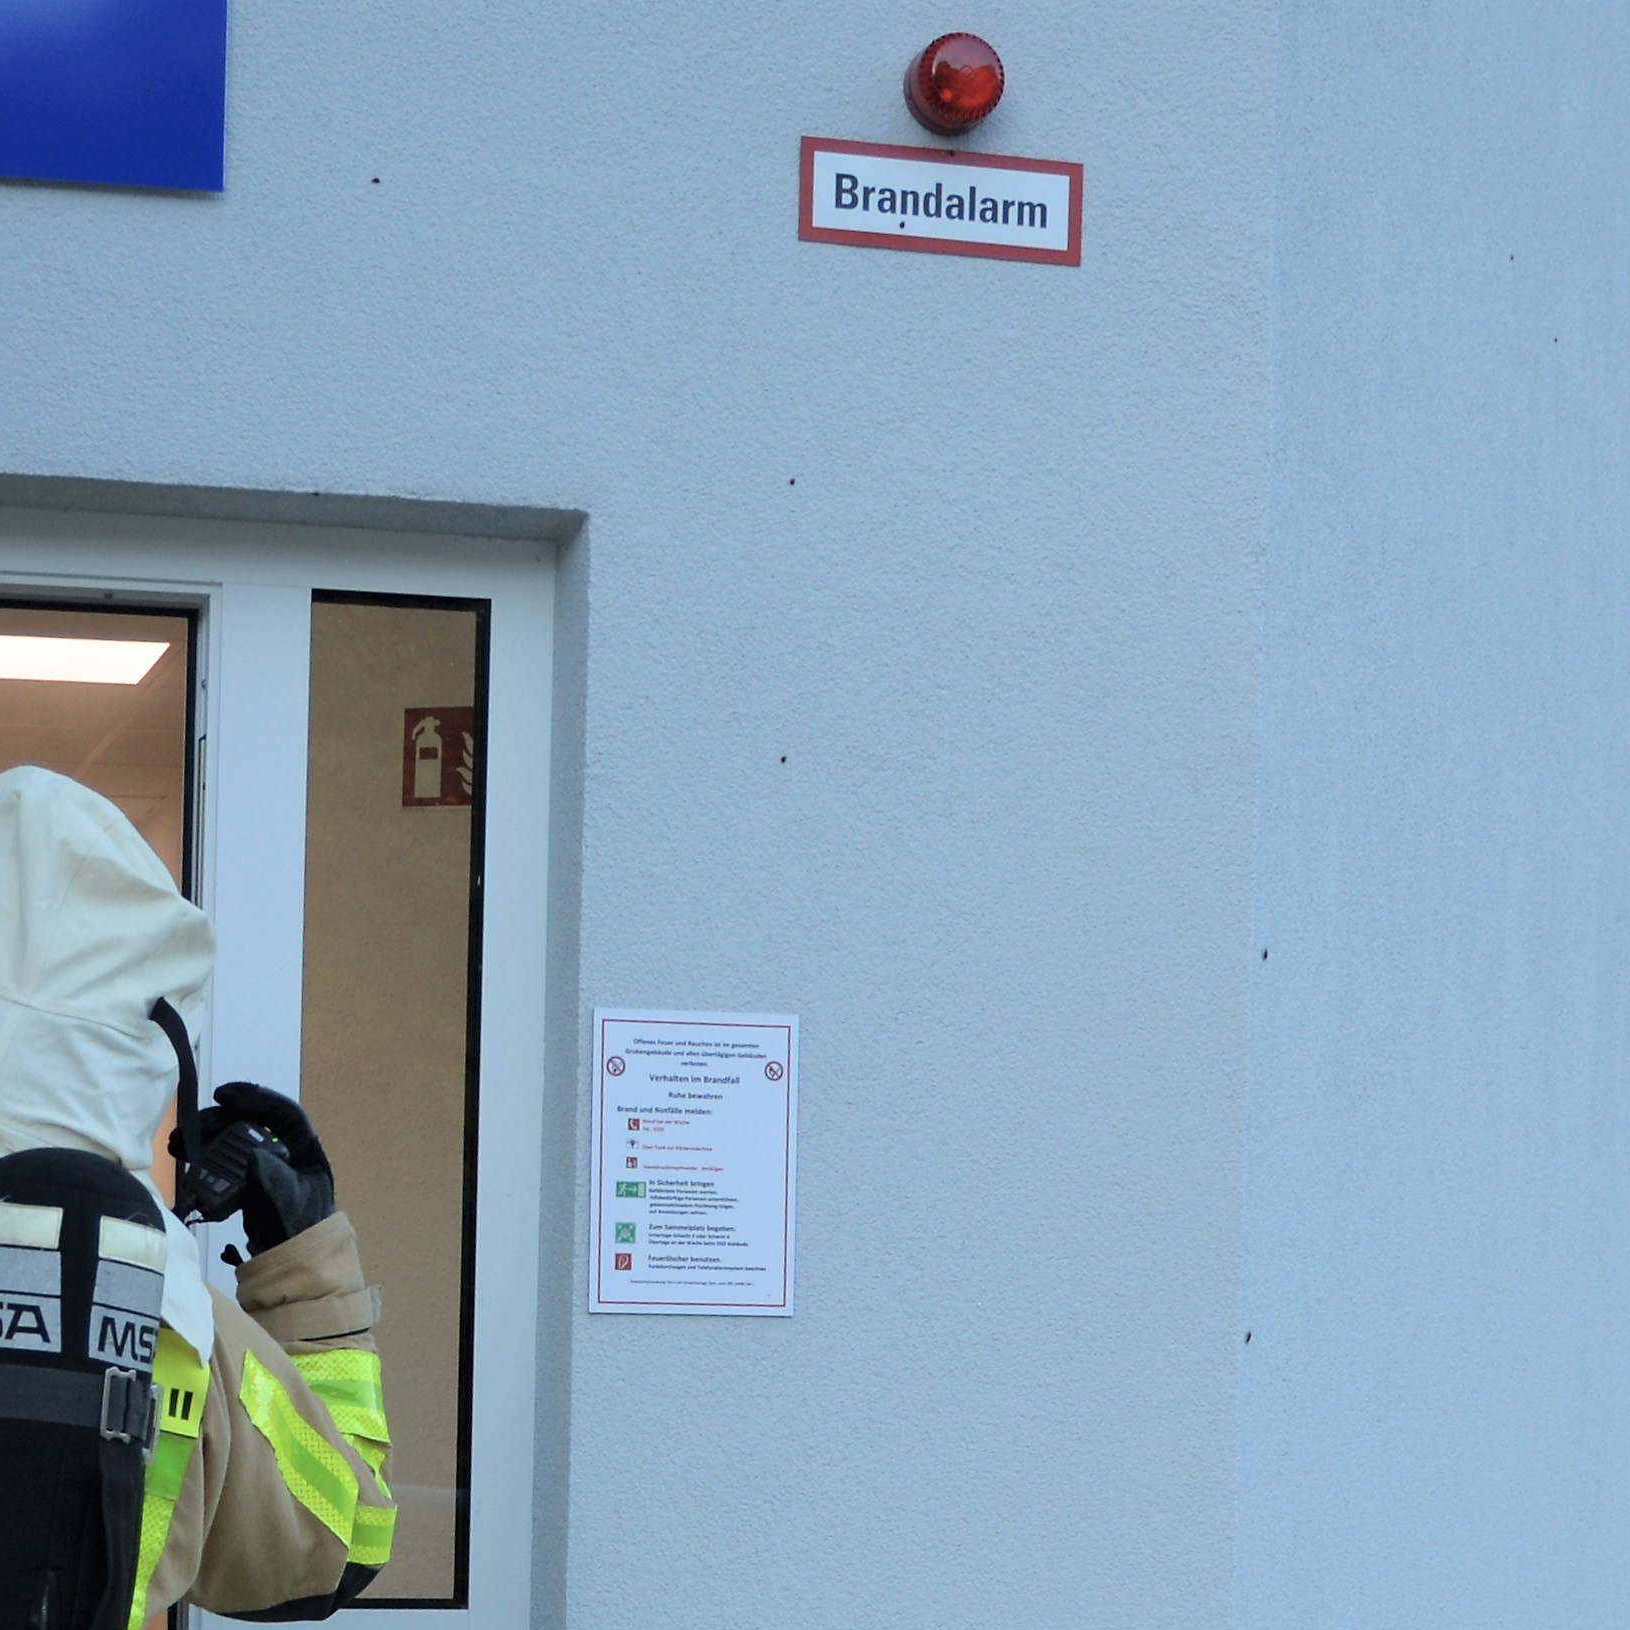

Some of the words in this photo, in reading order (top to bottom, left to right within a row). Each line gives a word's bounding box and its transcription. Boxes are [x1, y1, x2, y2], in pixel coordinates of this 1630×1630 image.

[835, 173, 1047, 229] Brandalarm
[649, 1074, 689, 1084] Verhalten
[691, 1076, 701, 1084] im
[703, 1076, 740, 1085] Brandfall
[668, 1091, 686, 1099] Ruhe
[688, 1092, 723, 1100] bewahren
[639, 1106, 653, 1114] und
[655, 1106, 682, 1115] Notfälle
[684, 1108, 713, 1116] melden:
[657, 1179, 689, 1187] Sicherheit
[690, 1180, 715, 1188] bringen
[665, 1224, 705, 1233] Sammelplatz
[648, 1255, 689, 1263] Feuerlöscher
[98, 1315, 157, 1364] MS
